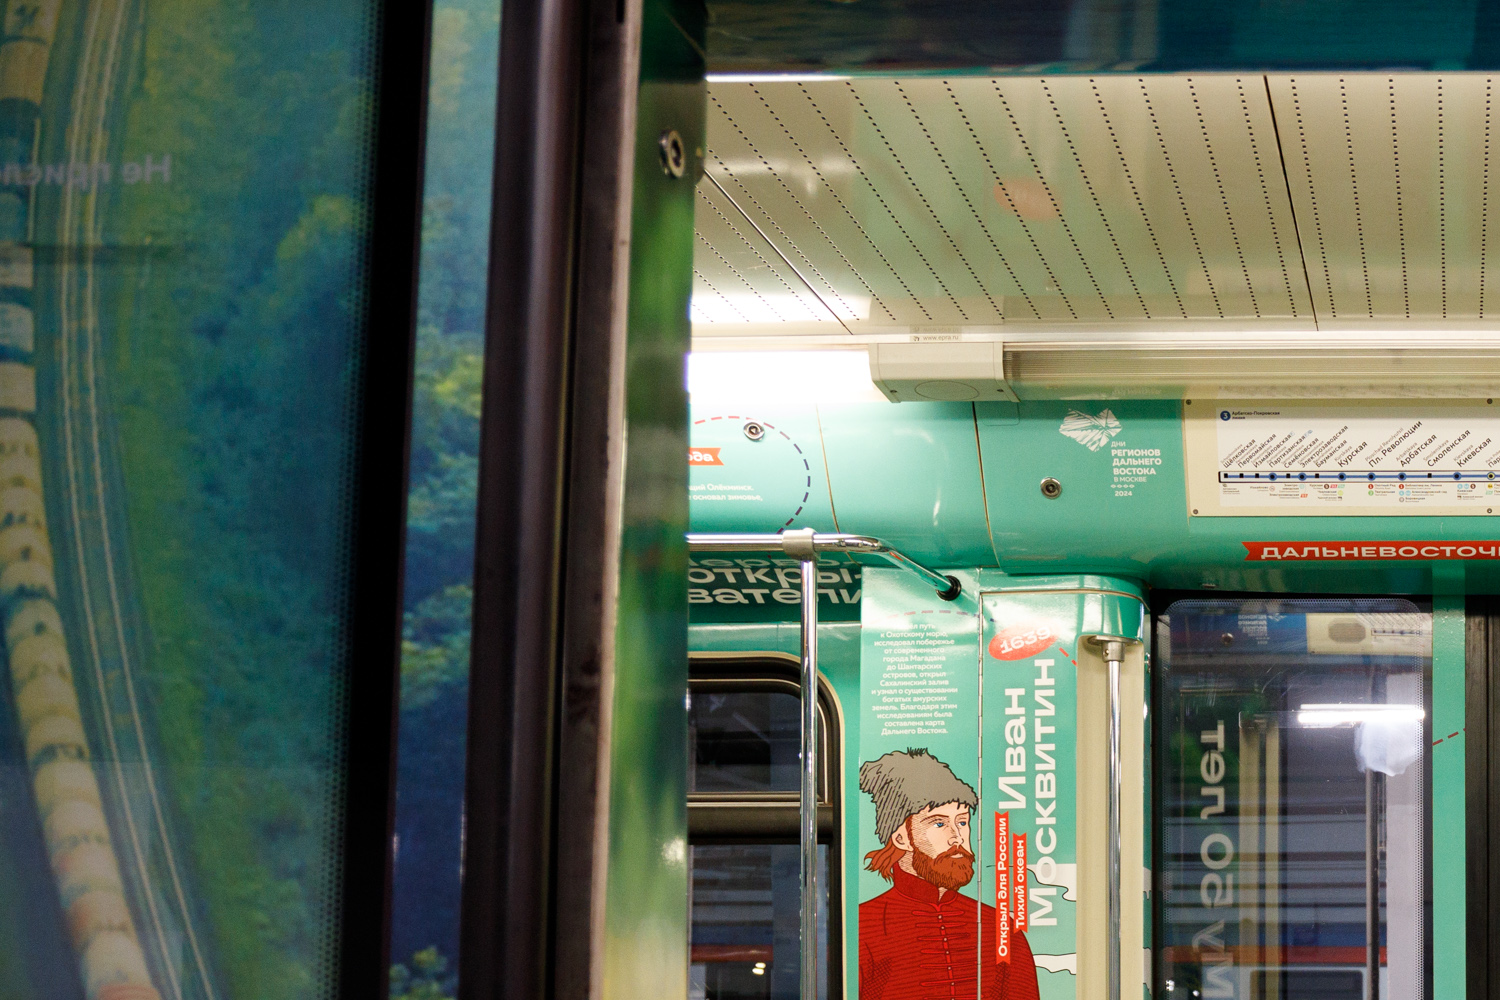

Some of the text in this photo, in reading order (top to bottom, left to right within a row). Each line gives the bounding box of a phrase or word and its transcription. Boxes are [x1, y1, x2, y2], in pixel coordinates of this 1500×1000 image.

[1238, 434, 1276, 468] Первомайская
[1254, 434, 1291, 468] Измайловская
[1269, 435, 1305, 468] Партизанская
[1284, 438, 1319, 468] Семёновская
[1301, 426, 1348, 468] Электрозаводская
[1316, 440, 1347, 467] Бауманская
[1338, 442, 1368, 467] Курская
[1368, 421, 1422, 467] Пл. Революции
[1400, 434, 1437, 467] Арбатская
[1427, 430, 1470, 467] Смоленская
[1457, 438, 1492, 467] Киевская
[1112, 458, 1162, 466] ДАЛЬНЕГО
[707, 483, 754, 491] Олёкминск.
[999, 626, 1052, 654] 1639
[881, 728, 916, 736] Дальнего
[998, 687, 1027, 810] Иван
[1029, 658, 1058, 927] Москвитин
[998, 818, 1009, 957] Открыл для России
[1015, 840, 1025, 929] Тихий океан
